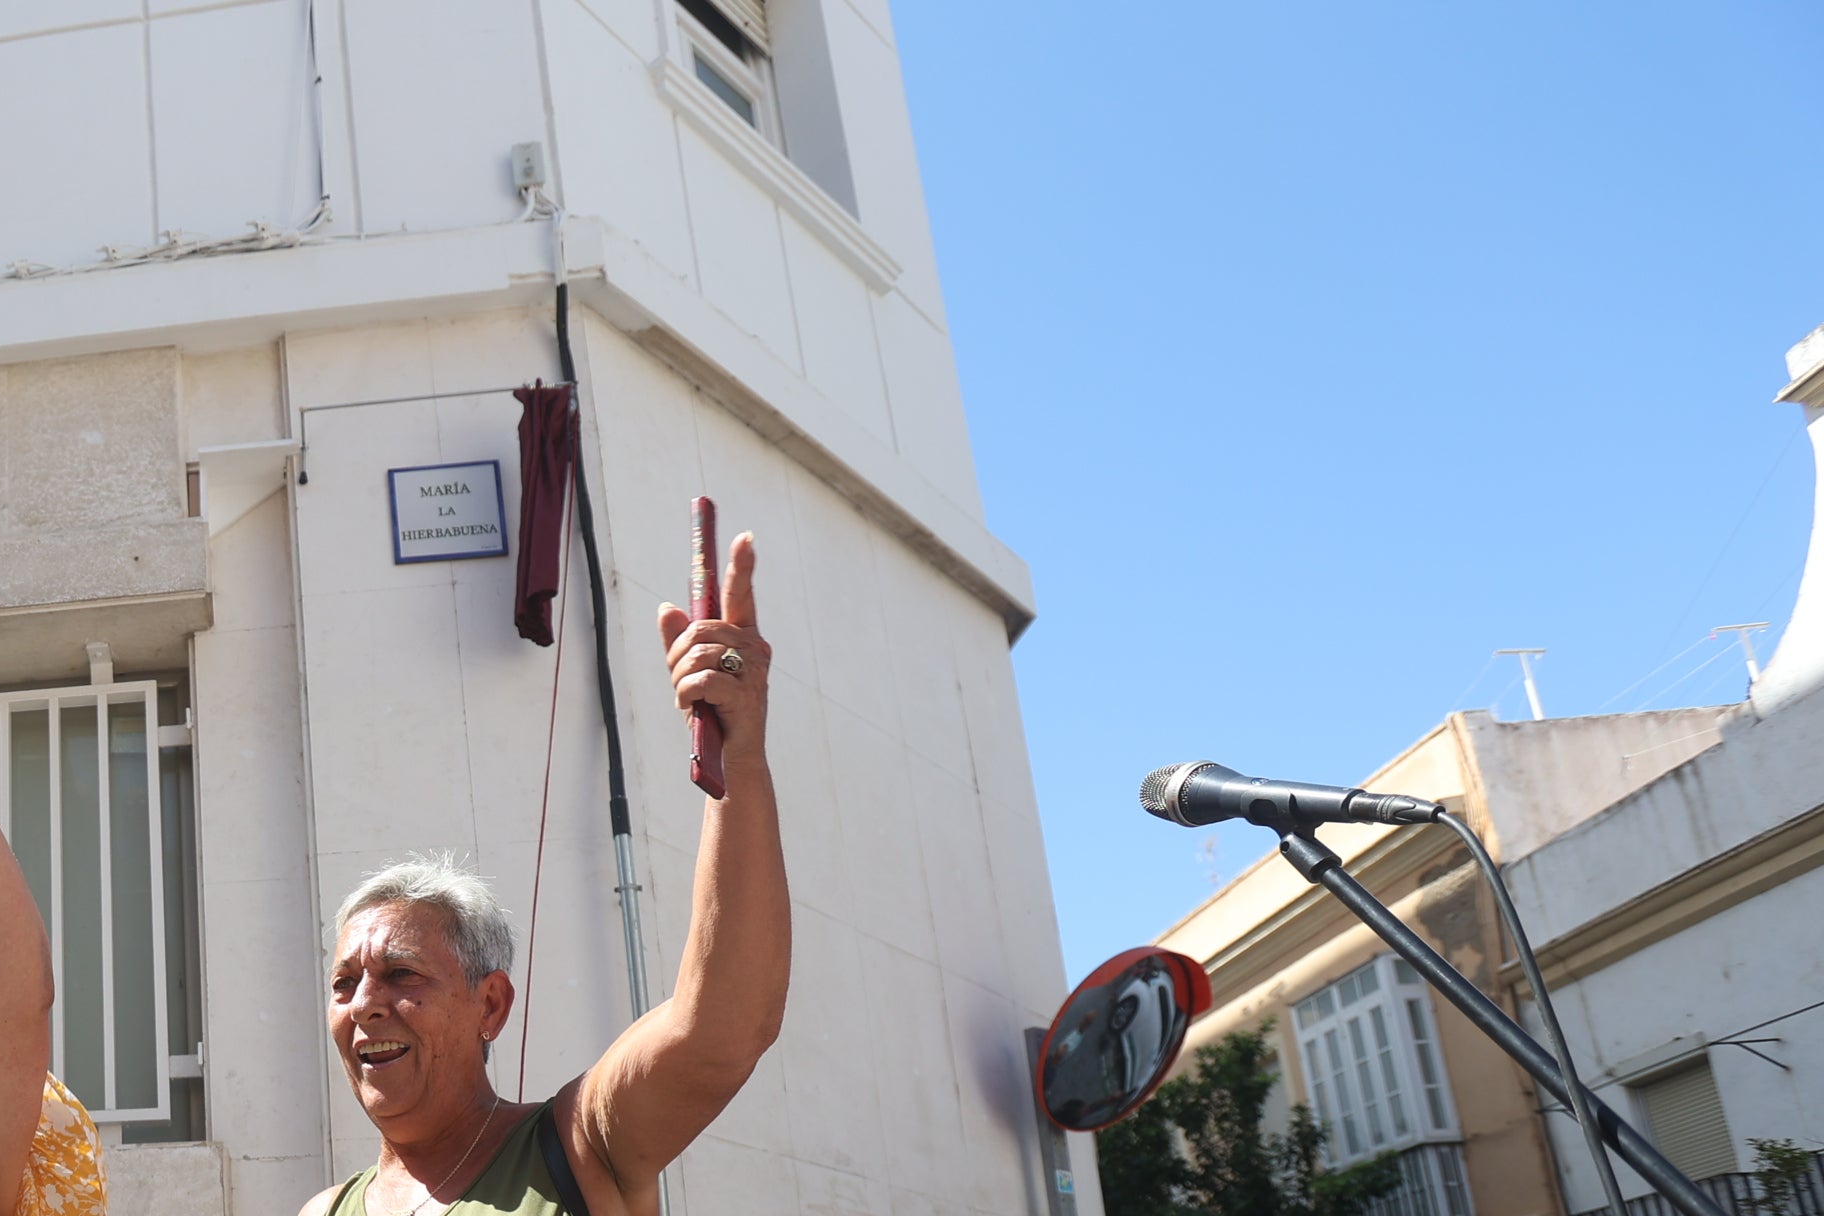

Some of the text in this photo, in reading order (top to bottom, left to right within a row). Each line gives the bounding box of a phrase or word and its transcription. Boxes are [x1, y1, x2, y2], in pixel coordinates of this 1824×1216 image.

[419, 481, 471, 498] MARÍA
[438, 506, 456, 516] LA
[401, 523, 498, 541] HIERBABUENA
